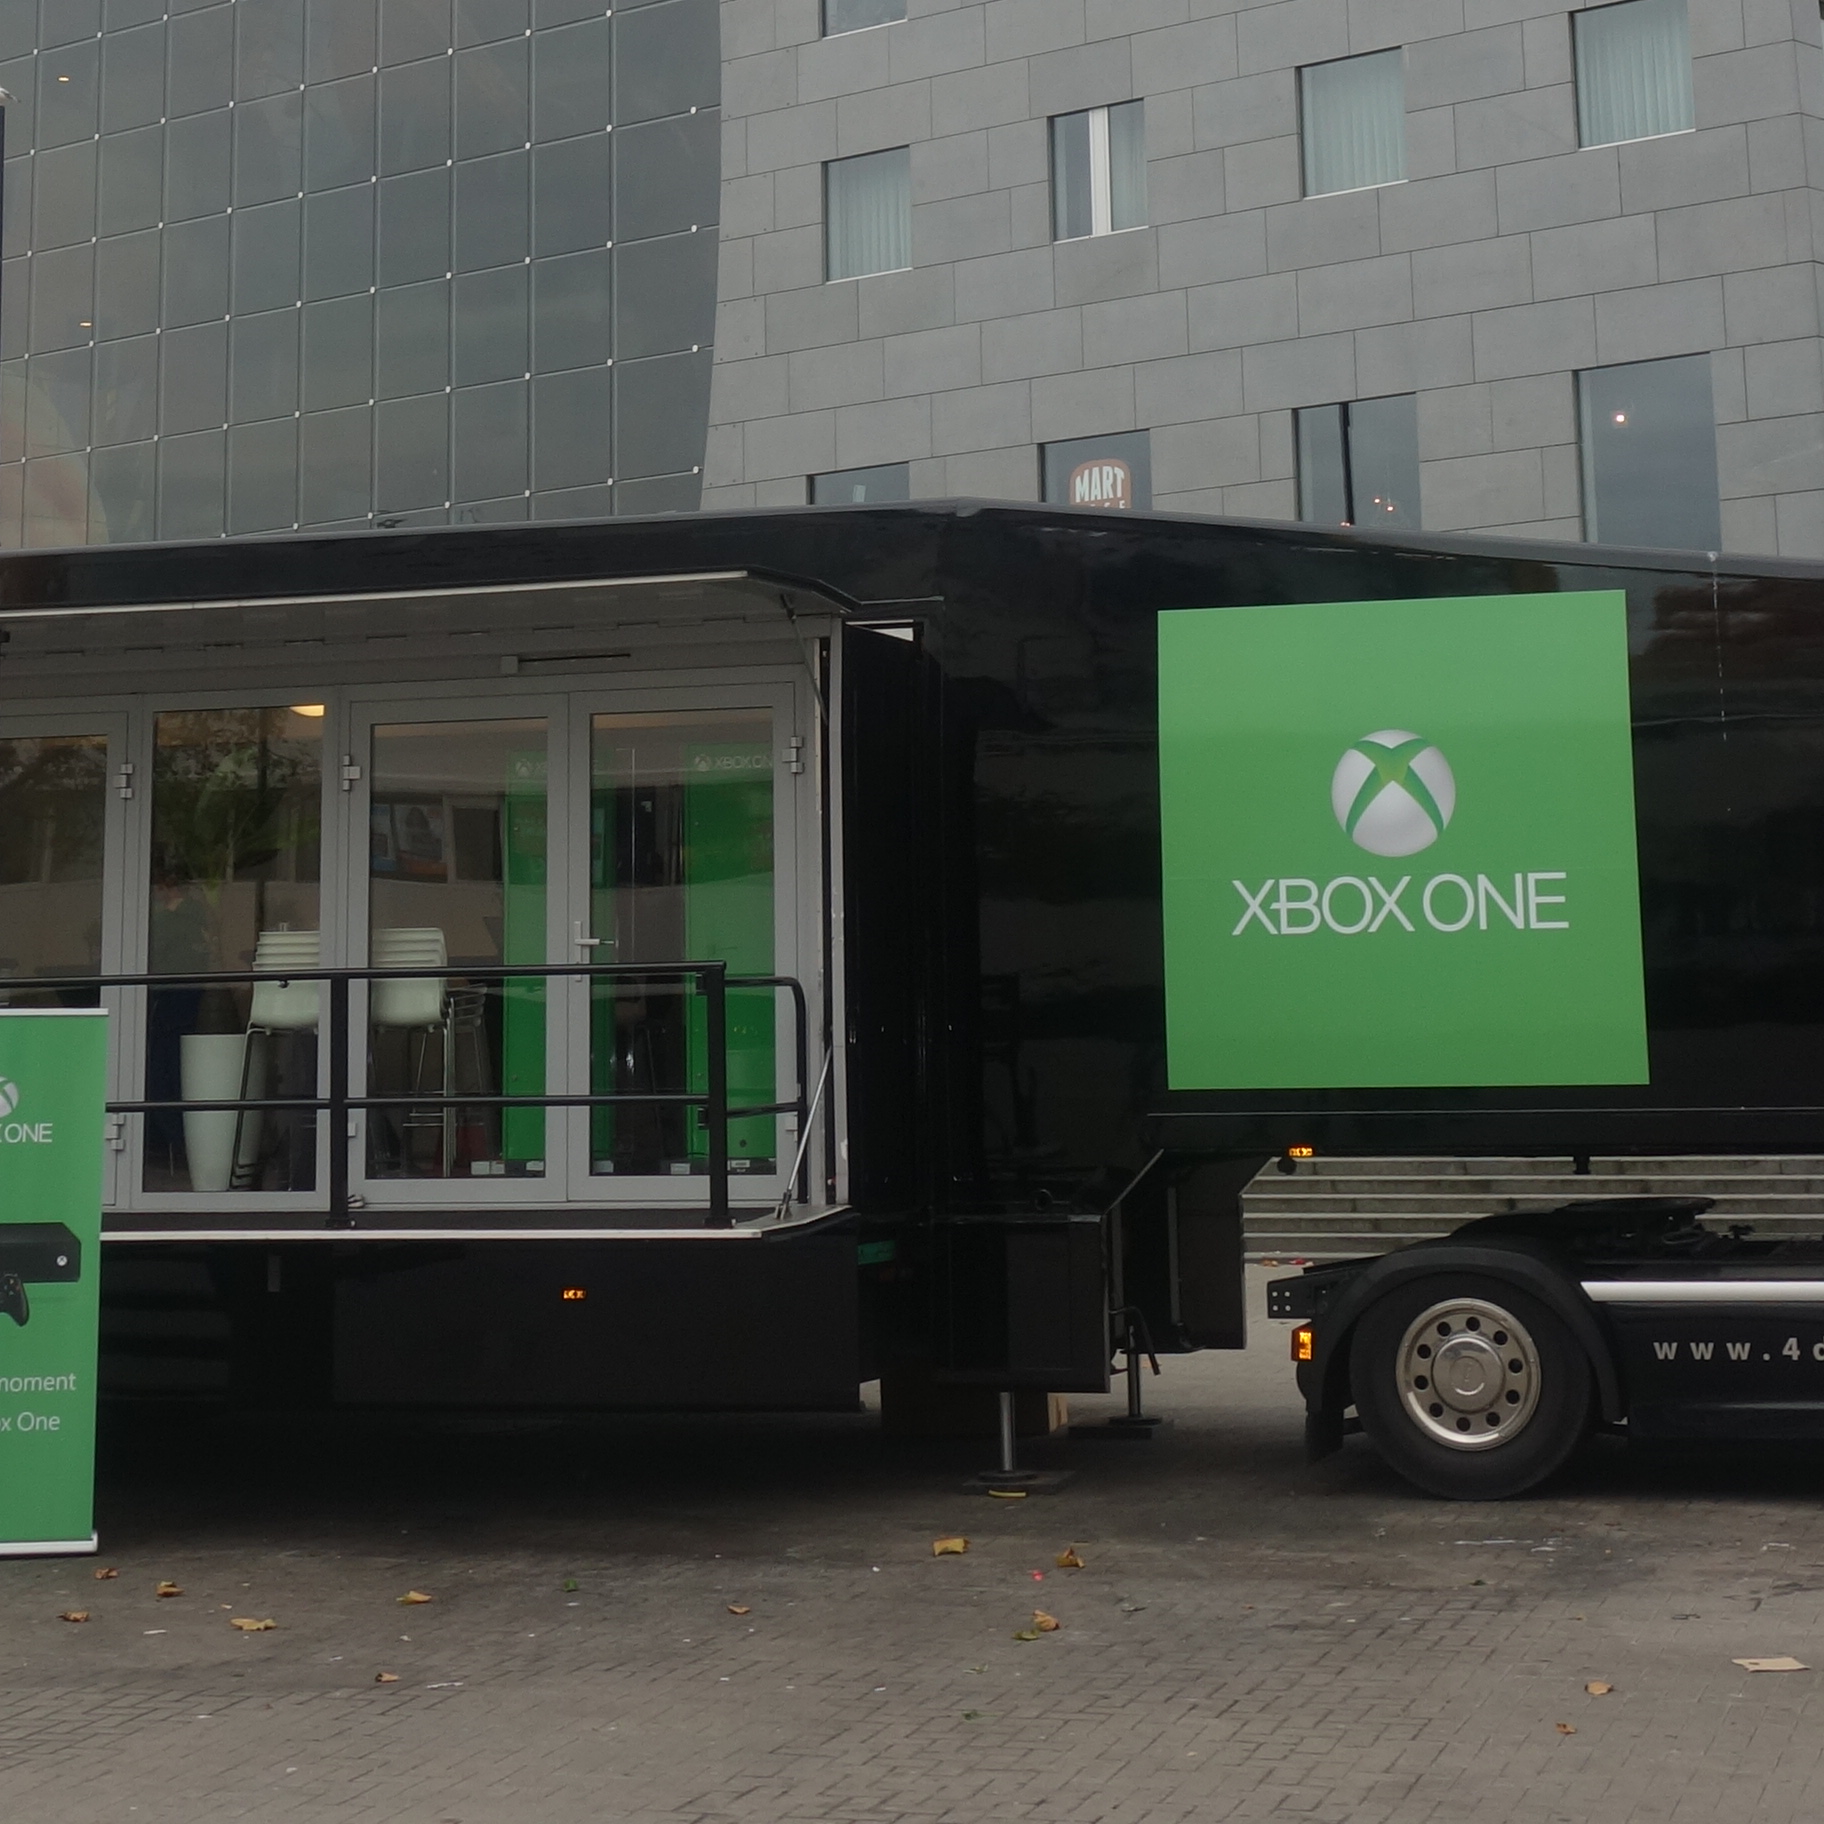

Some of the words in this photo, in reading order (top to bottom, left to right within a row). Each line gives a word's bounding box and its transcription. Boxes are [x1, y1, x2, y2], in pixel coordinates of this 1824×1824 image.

[1075, 466, 1125, 503] MART
[1232, 875, 1415, 936] XBOX
[1422, 871, 1570, 933] ONE
[5, 1123, 53, 1143] ONE
[17, 1411, 61, 1431] One
